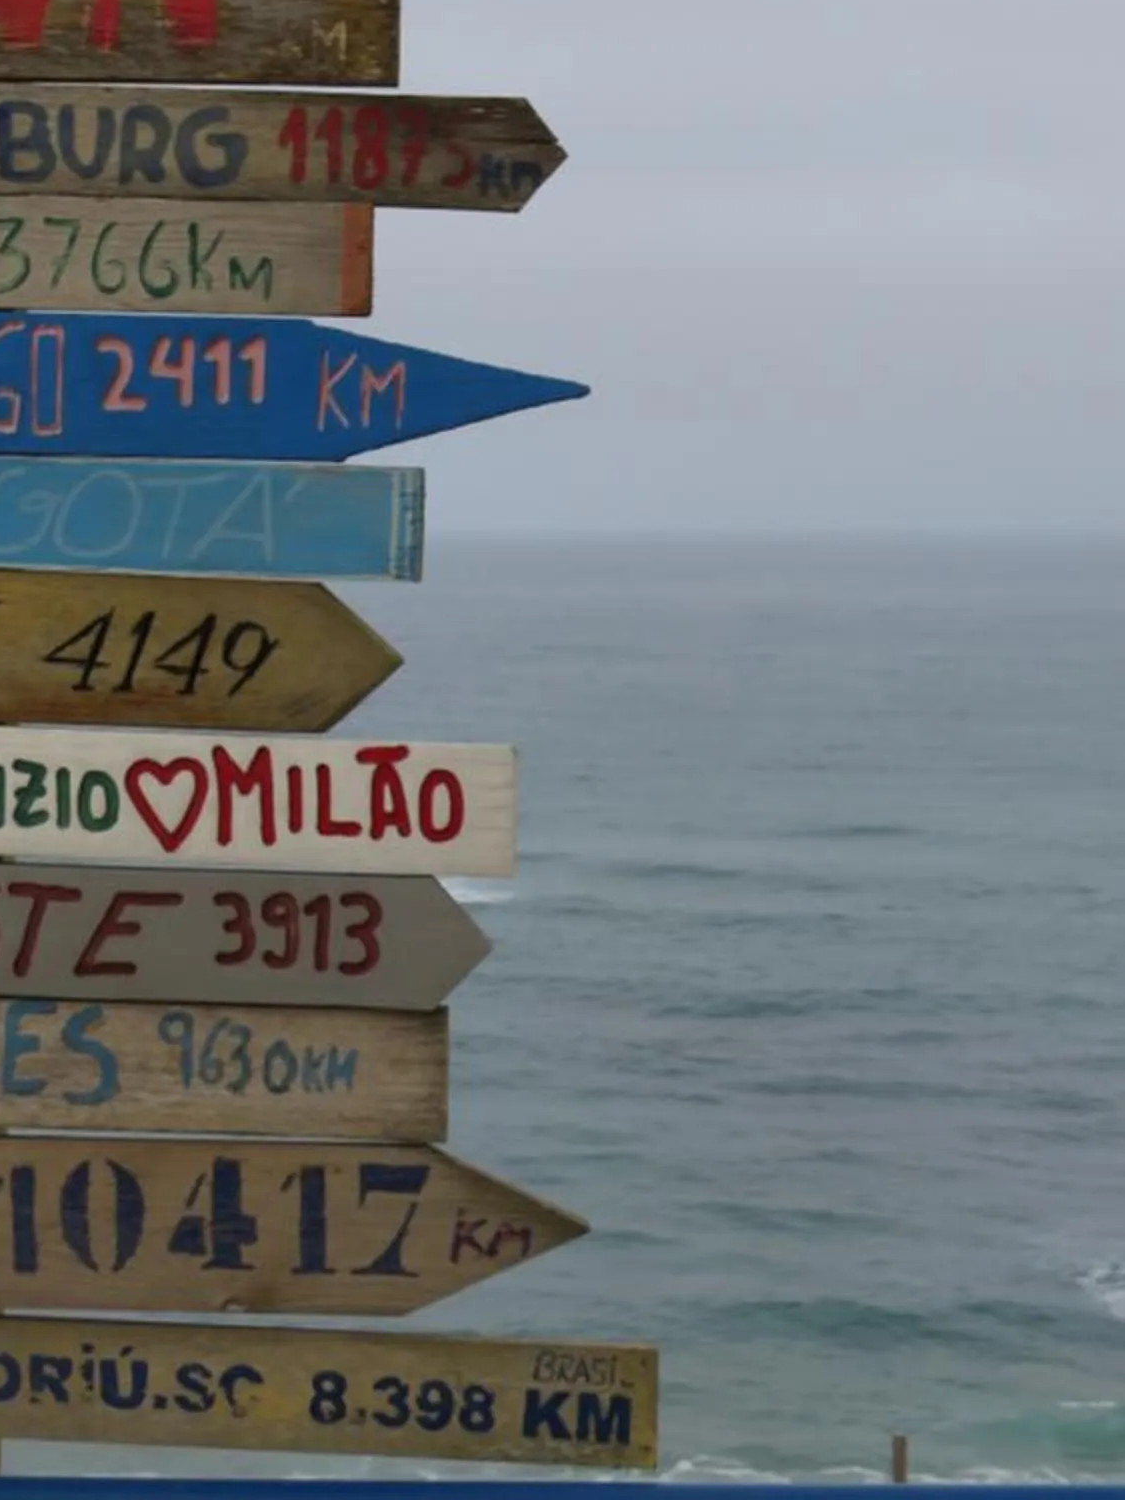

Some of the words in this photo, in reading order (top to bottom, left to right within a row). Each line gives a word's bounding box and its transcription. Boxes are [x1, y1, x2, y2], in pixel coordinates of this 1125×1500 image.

[96, 335, 267, 413] 2411
[316, 349, 408, 433] KM
[41, 604, 282, 698] 4149
[213, 890, 386, 977] 3913
[521, 1388, 634, 1447] KM
